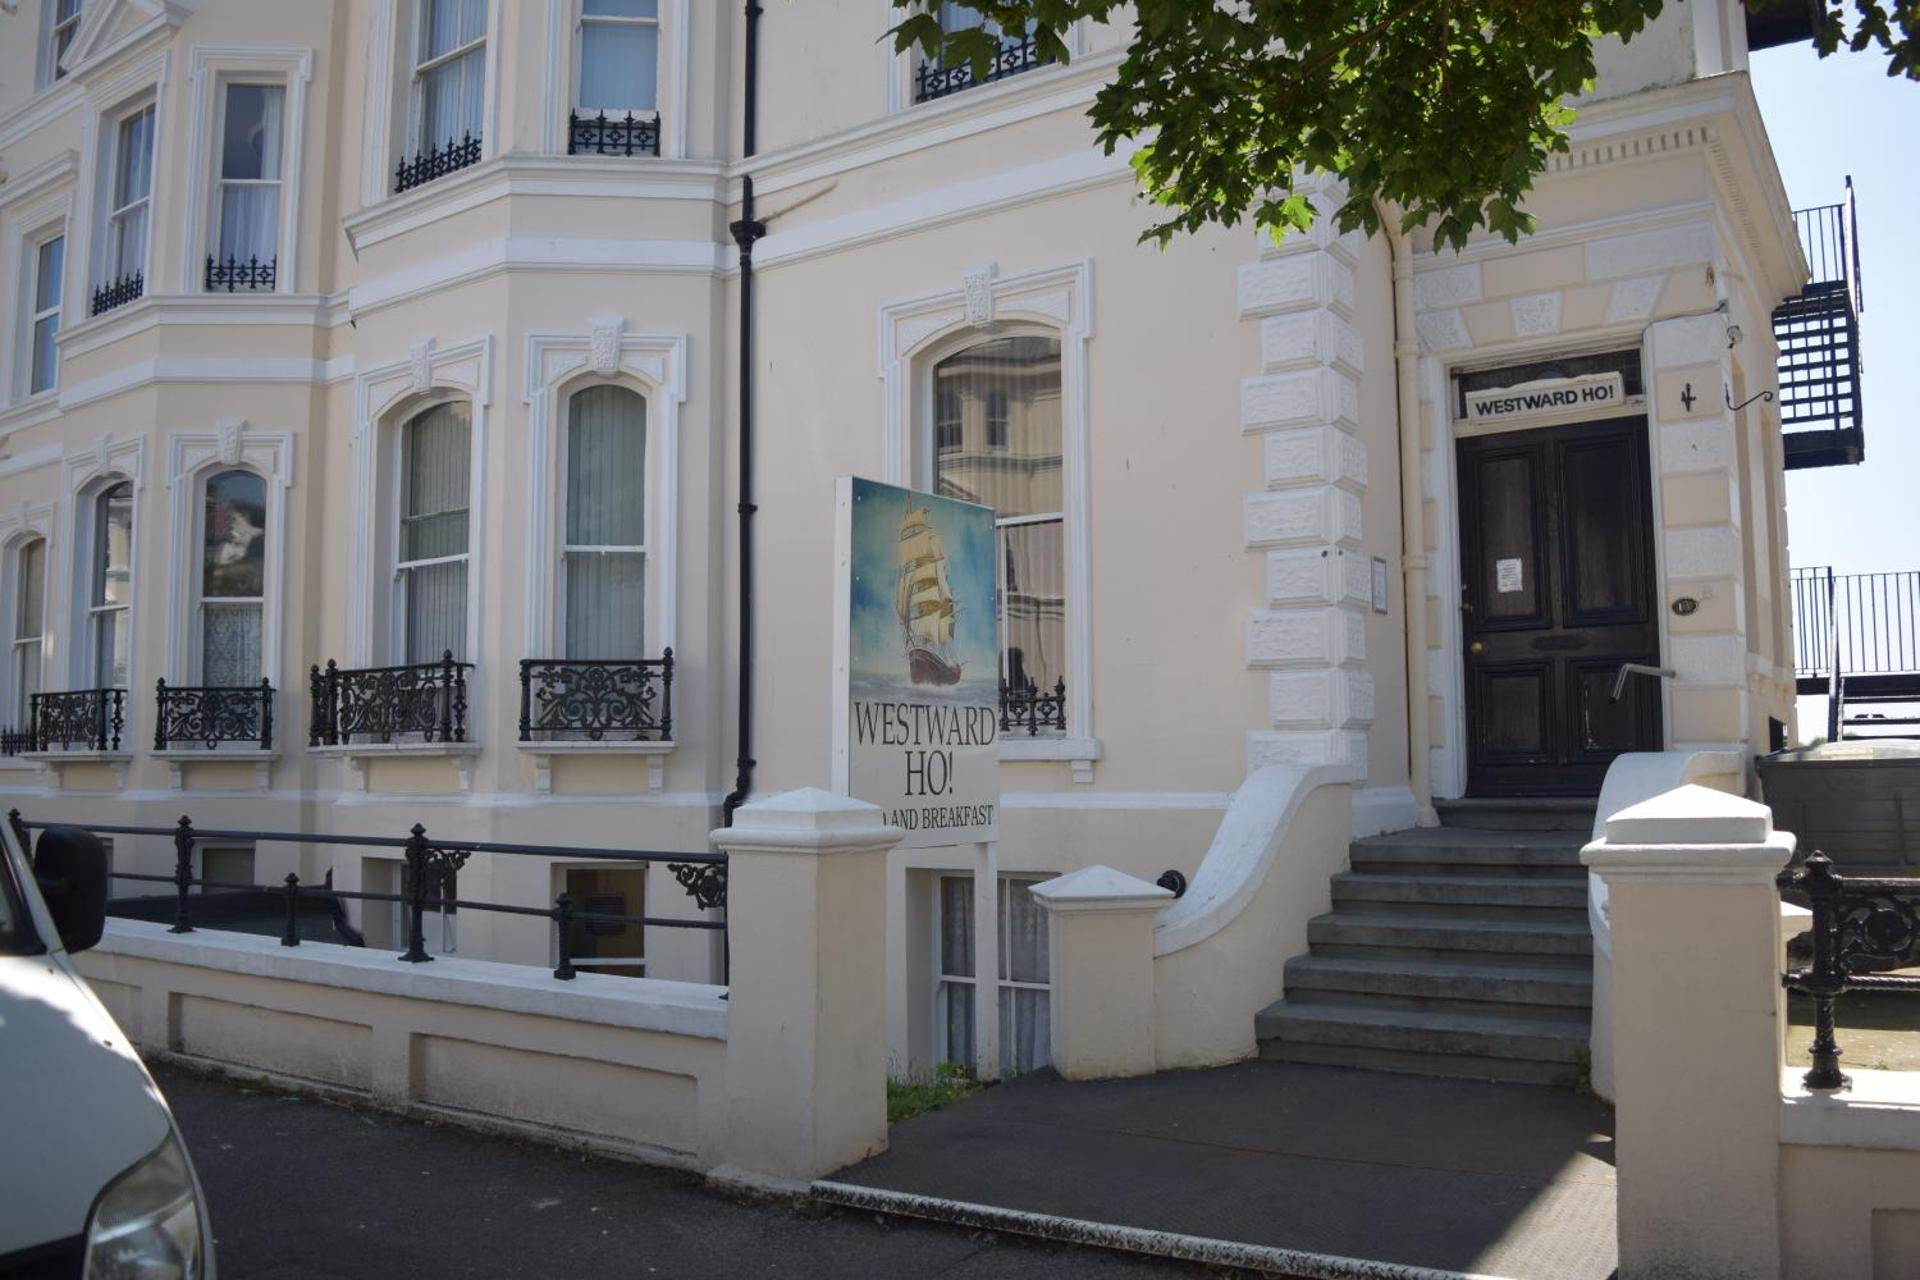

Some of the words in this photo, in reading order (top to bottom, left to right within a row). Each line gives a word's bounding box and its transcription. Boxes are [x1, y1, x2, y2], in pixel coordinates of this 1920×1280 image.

[1475, 390, 1578, 416] WESTWARD
[1582, 385, 1614, 402] HO!
[1681, 383, 1696, 412] 4
[854, 701, 996, 746] WESTWARD
[904, 750, 953, 796] HO!
[891, 809, 919, 831] AND
[922, 804, 994, 829] BREAKFAST
